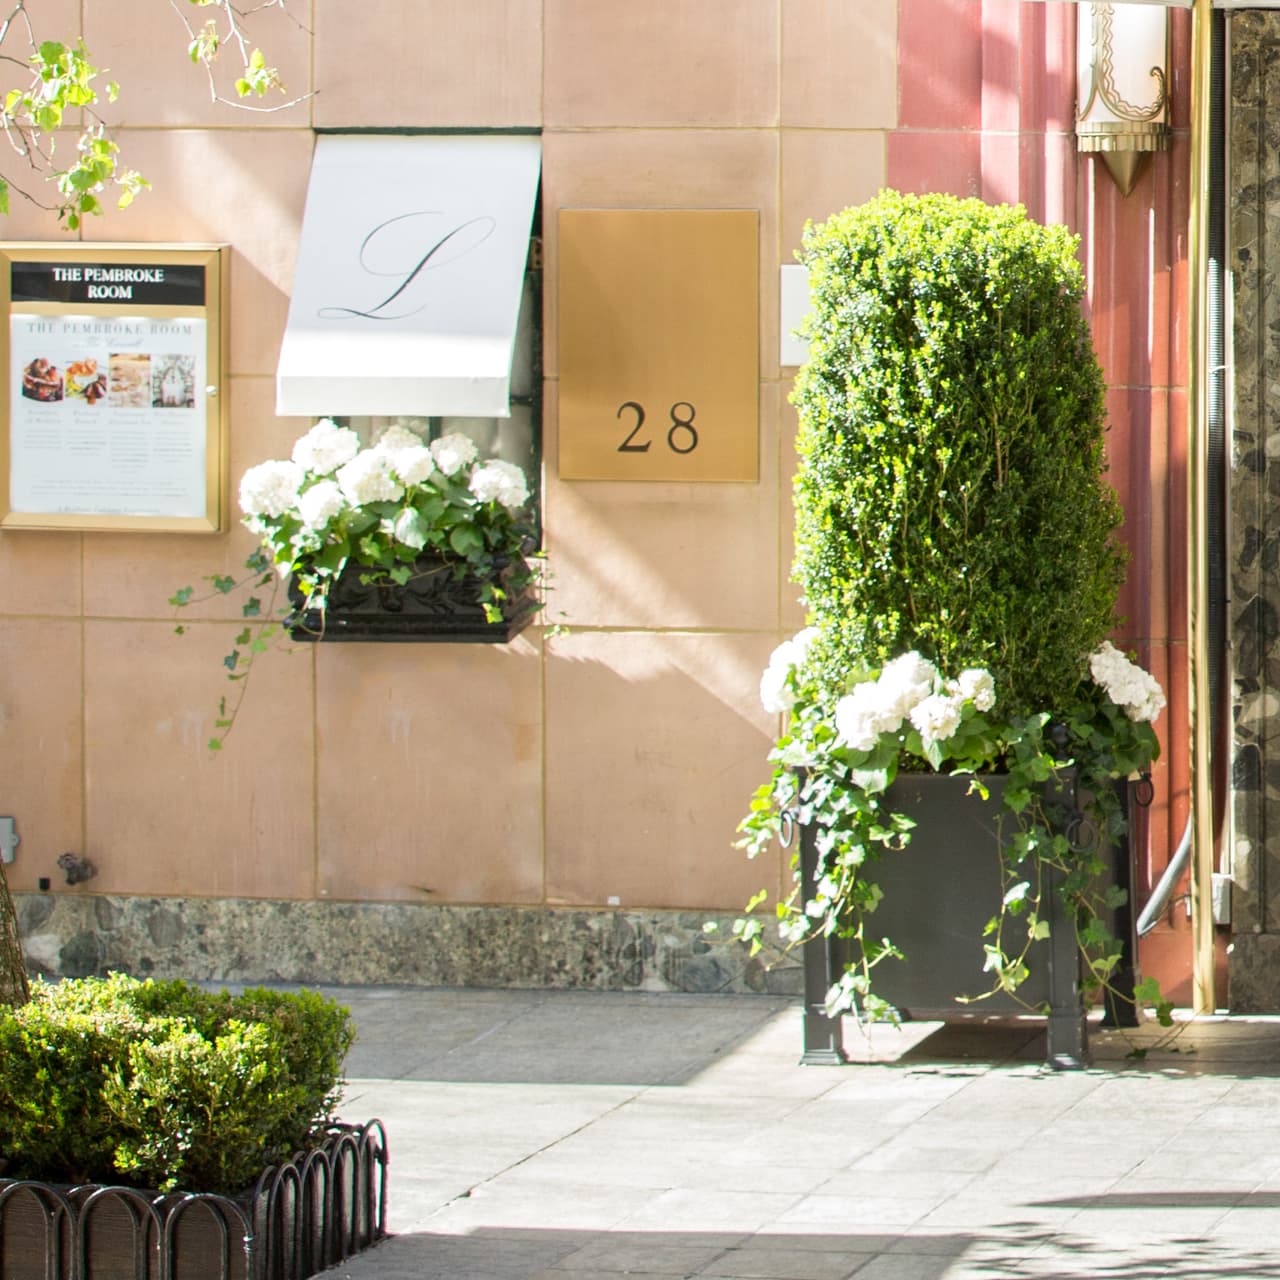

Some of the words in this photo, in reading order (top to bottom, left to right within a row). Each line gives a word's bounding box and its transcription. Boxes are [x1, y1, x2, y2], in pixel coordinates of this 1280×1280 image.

[52, 268, 82, 282] THE
[84, 268, 165, 283] PEMBROKE
[87, 285, 133, 299] ROOM
[28, 323, 56, 333] THE
[63, 323, 144, 335] PEMBROKE
[150, 324, 193, 335] ROOM
[616, 401, 699, 455] 28
